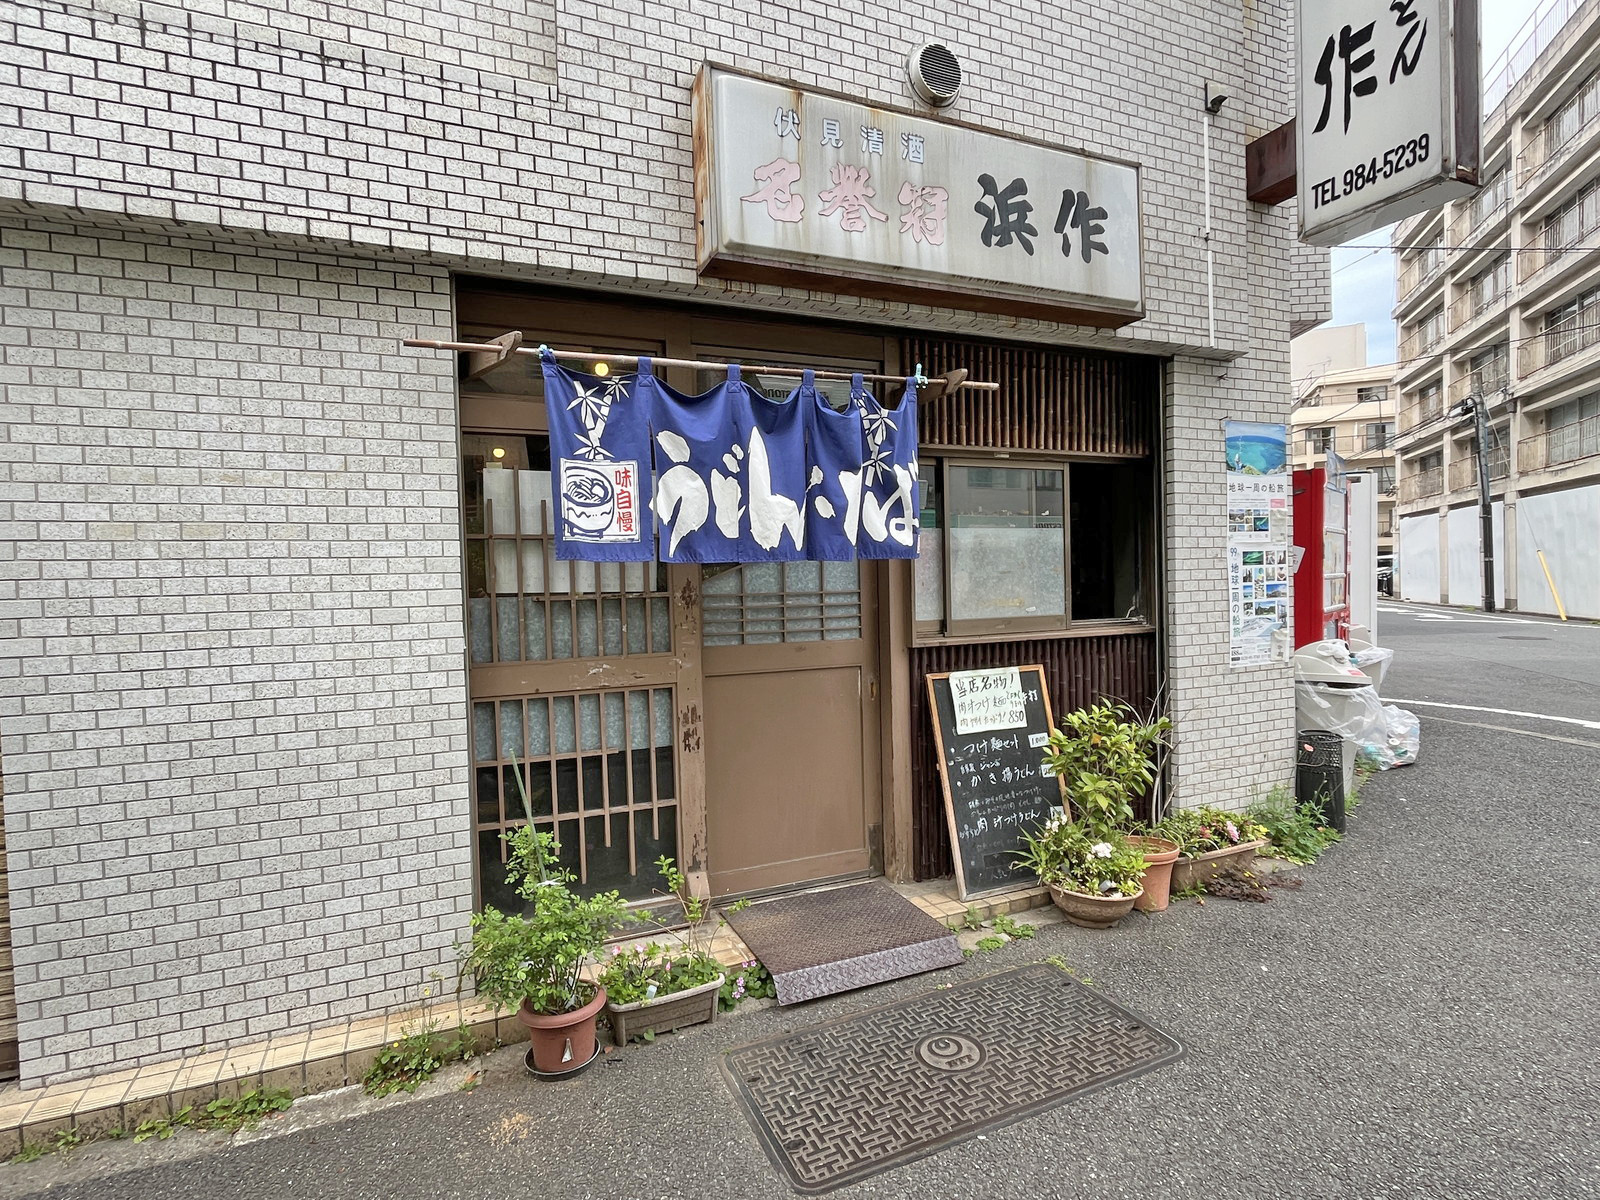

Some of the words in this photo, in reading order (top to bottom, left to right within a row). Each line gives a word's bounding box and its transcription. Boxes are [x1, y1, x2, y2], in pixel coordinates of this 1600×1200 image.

[1312, 20, 1378, 136] 作
[773, 106, 925, 164] 伏見清酒
[1311, 176, 1341, 210] TEL
[1342, 133, 1430, 196] 984-5239
[973, 172, 1110, 264] 浜作
[614, 466, 634, 533] 味自慢
[1228, 482, 1285, 493] 地球一周の船旅
[1230, 562, 1241, 638] 地球一周の船旅
[1008, 709, 1024, 724] 850
